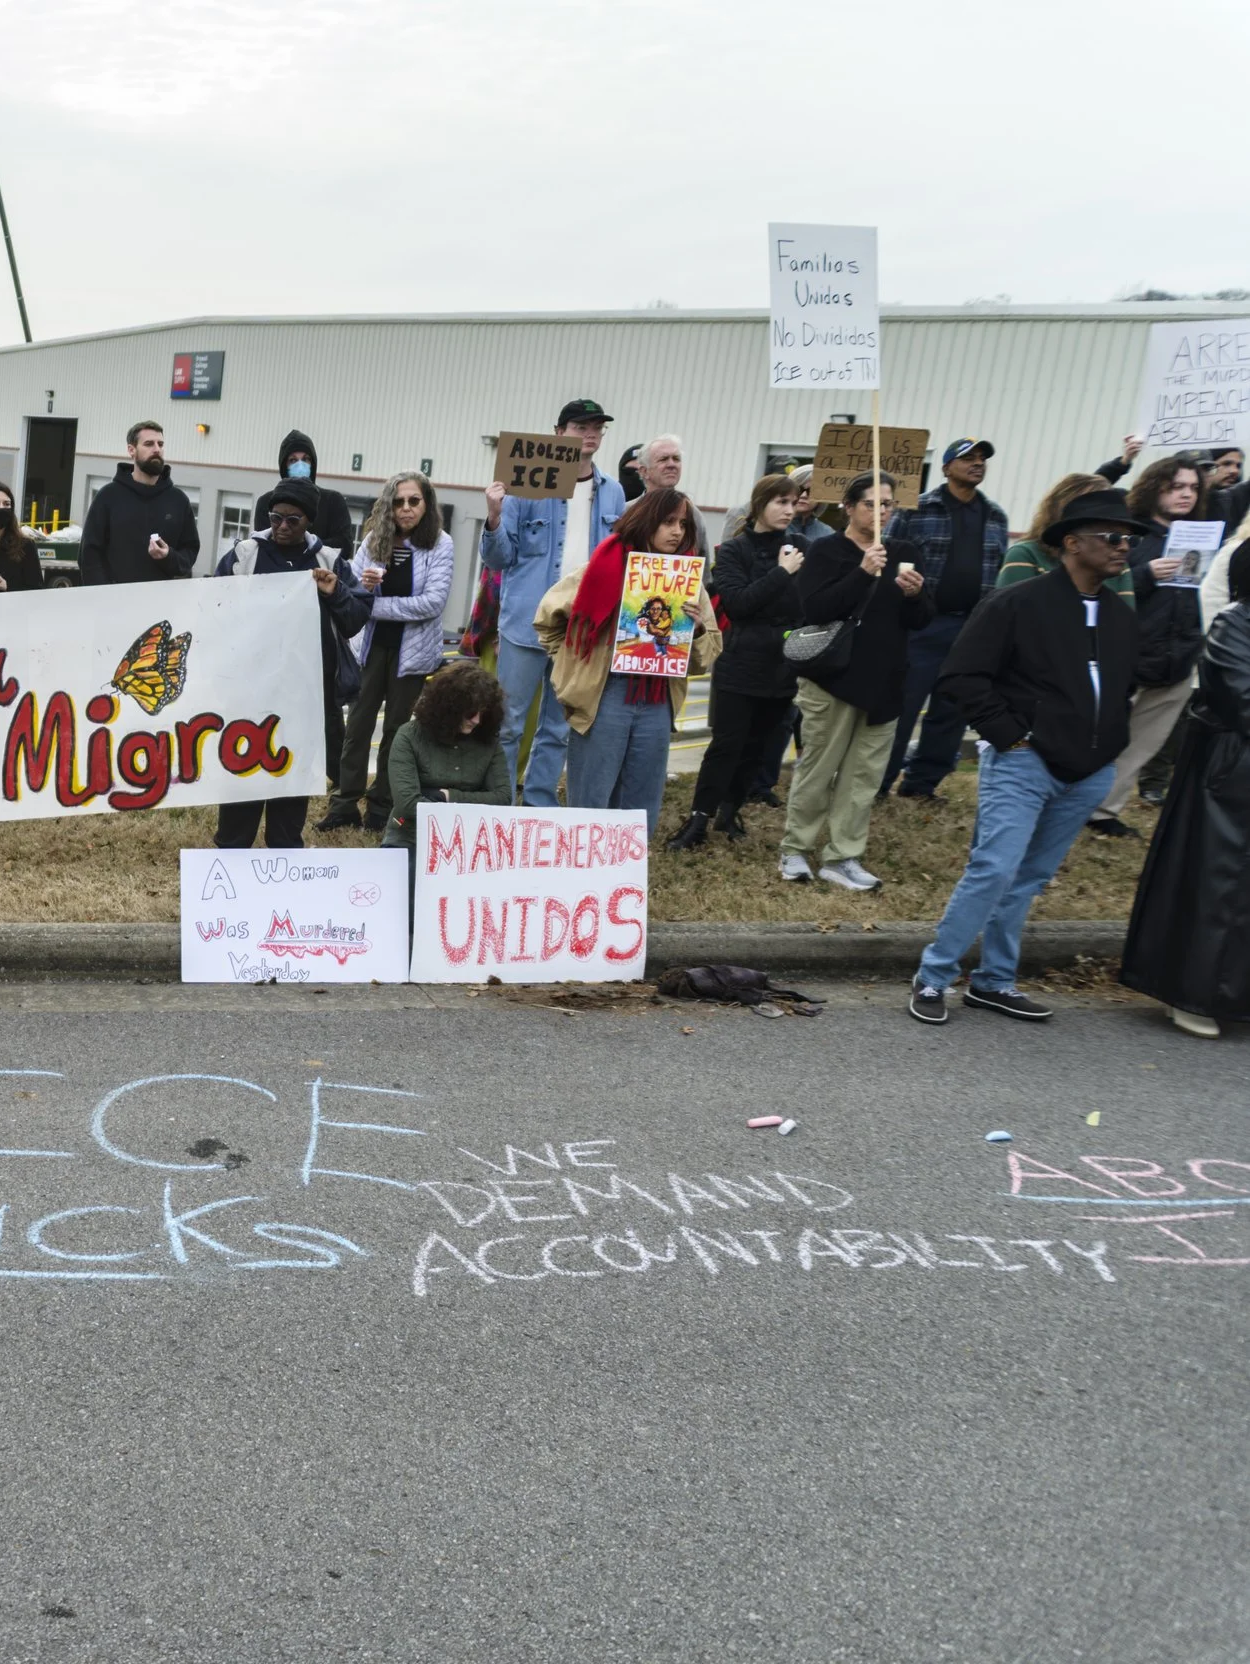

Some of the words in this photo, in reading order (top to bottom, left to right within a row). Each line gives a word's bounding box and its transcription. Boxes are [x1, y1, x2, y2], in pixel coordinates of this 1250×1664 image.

[777, 239, 860, 274] Familias
[794, 280, 854, 308] Unidas
[773, 317, 796, 348] No
[802, 321, 877, 349] Divididas
[773, 361, 802, 384] ICE
[854, 357, 877, 382] TN
[1162, 373, 1195, 387] THE
[892, 435, 911, 455] is
[1148, 419, 1237, 444] ABOLISH
[509, 438, 581, 463] ABOLISH
[819, 456, 837, 469] a
[510, 465, 560, 489] ICE
[630, 556, 669, 571] FREE
[672, 559, 702, 577] OUR
[628, 571, 701, 597] FUTURE
[612, 653, 660, 672] ABOLISH
[662, 657, 688, 675] ICE
[2, 690, 295, 811] Migra
[201, 857, 237, 901] A
[251, 856, 340, 885] Woman
[195, 916, 250, 943] Was
[263, 909, 366, 941] Murdered
[437, 882, 646, 968] UNIDOS
[227, 951, 311, 982] Yesterday
[456, 1138, 618, 1176] WE
[417, 1171, 855, 1228] DEMAND
[412, 1225, 1119, 1297] ACCOUNTABILITY
